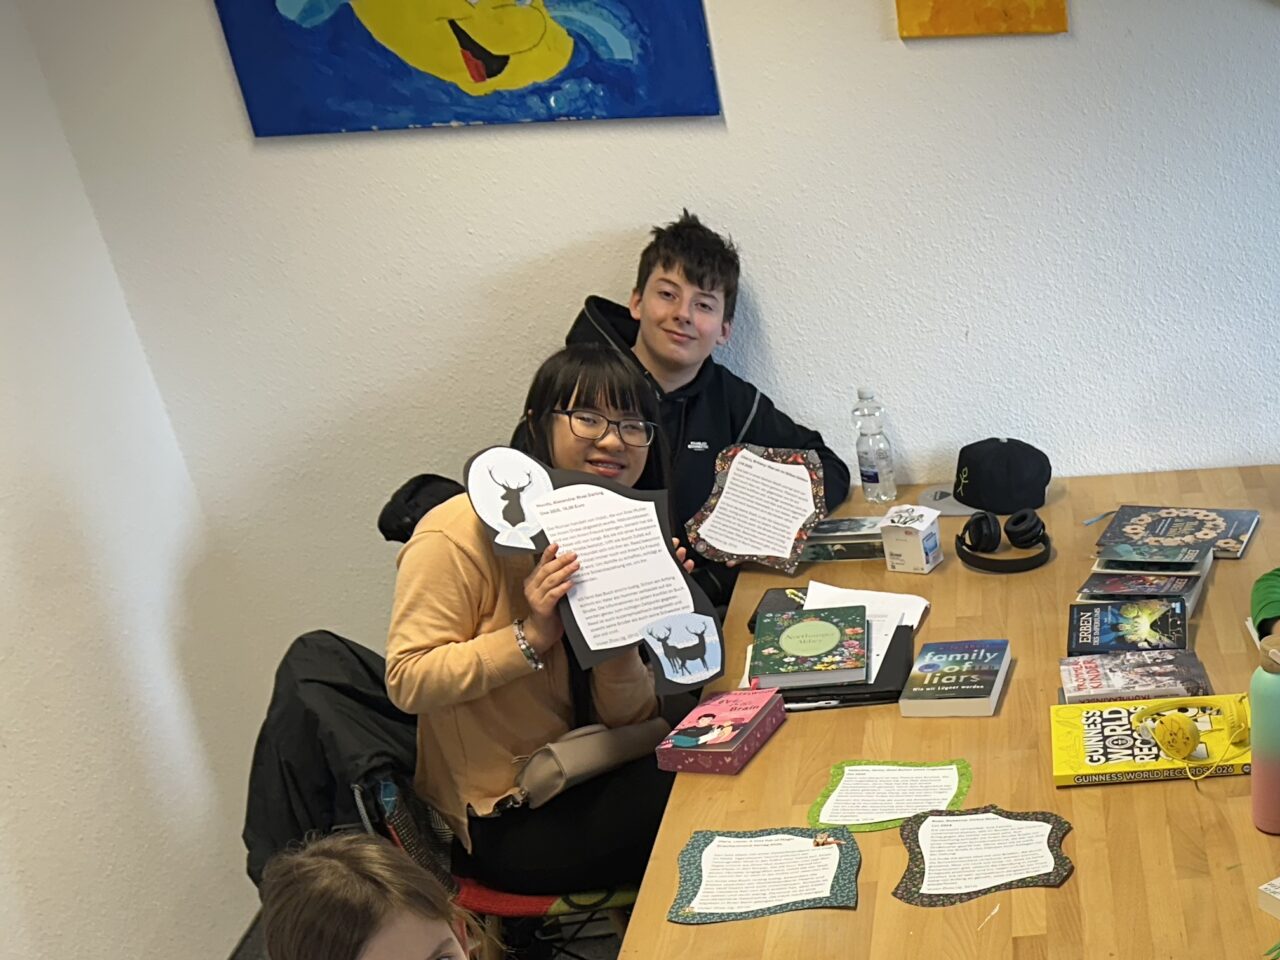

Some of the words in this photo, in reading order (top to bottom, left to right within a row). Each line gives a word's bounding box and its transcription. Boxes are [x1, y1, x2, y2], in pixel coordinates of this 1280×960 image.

[1079, 612, 1092, 643] ERBEN
[924, 649, 999, 663] family
[943, 661, 973, 672] of
[923, 672, 980, 684] liars
[1084, 659, 1103, 689] KINDER
[1082, 710, 1106, 766] GUINNESS
[1102, 707, 1134, 764] WORLD
[1074, 773, 1124, 784] GUINNESS
[1124, 770, 1161, 780] WORLD
[1211, 765, 1234, 775] 2026
